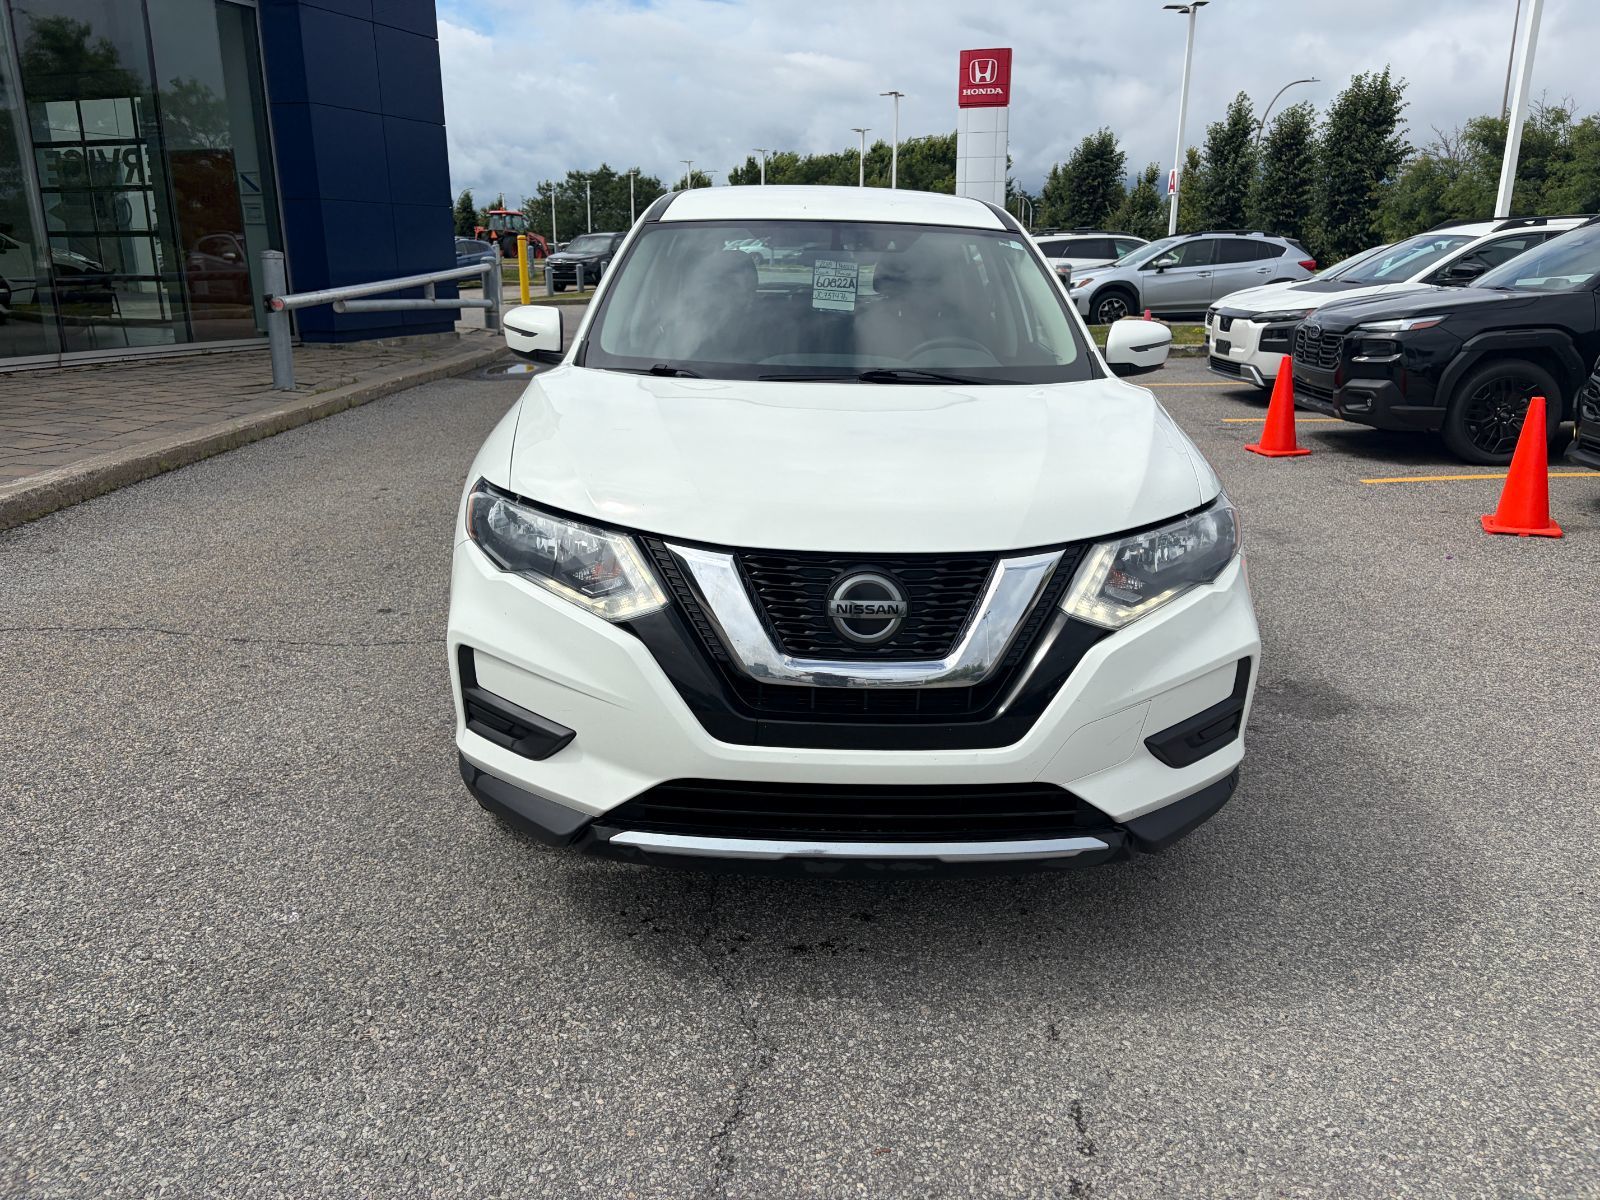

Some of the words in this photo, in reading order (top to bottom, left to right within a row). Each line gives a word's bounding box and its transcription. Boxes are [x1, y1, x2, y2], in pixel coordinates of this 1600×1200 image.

[962, 88, 1003, 96] HONDA
[1168, 170, 1176, 193] A
[816, 276, 855, 288] 60822A
[836, 604, 898, 615] NISSAN
